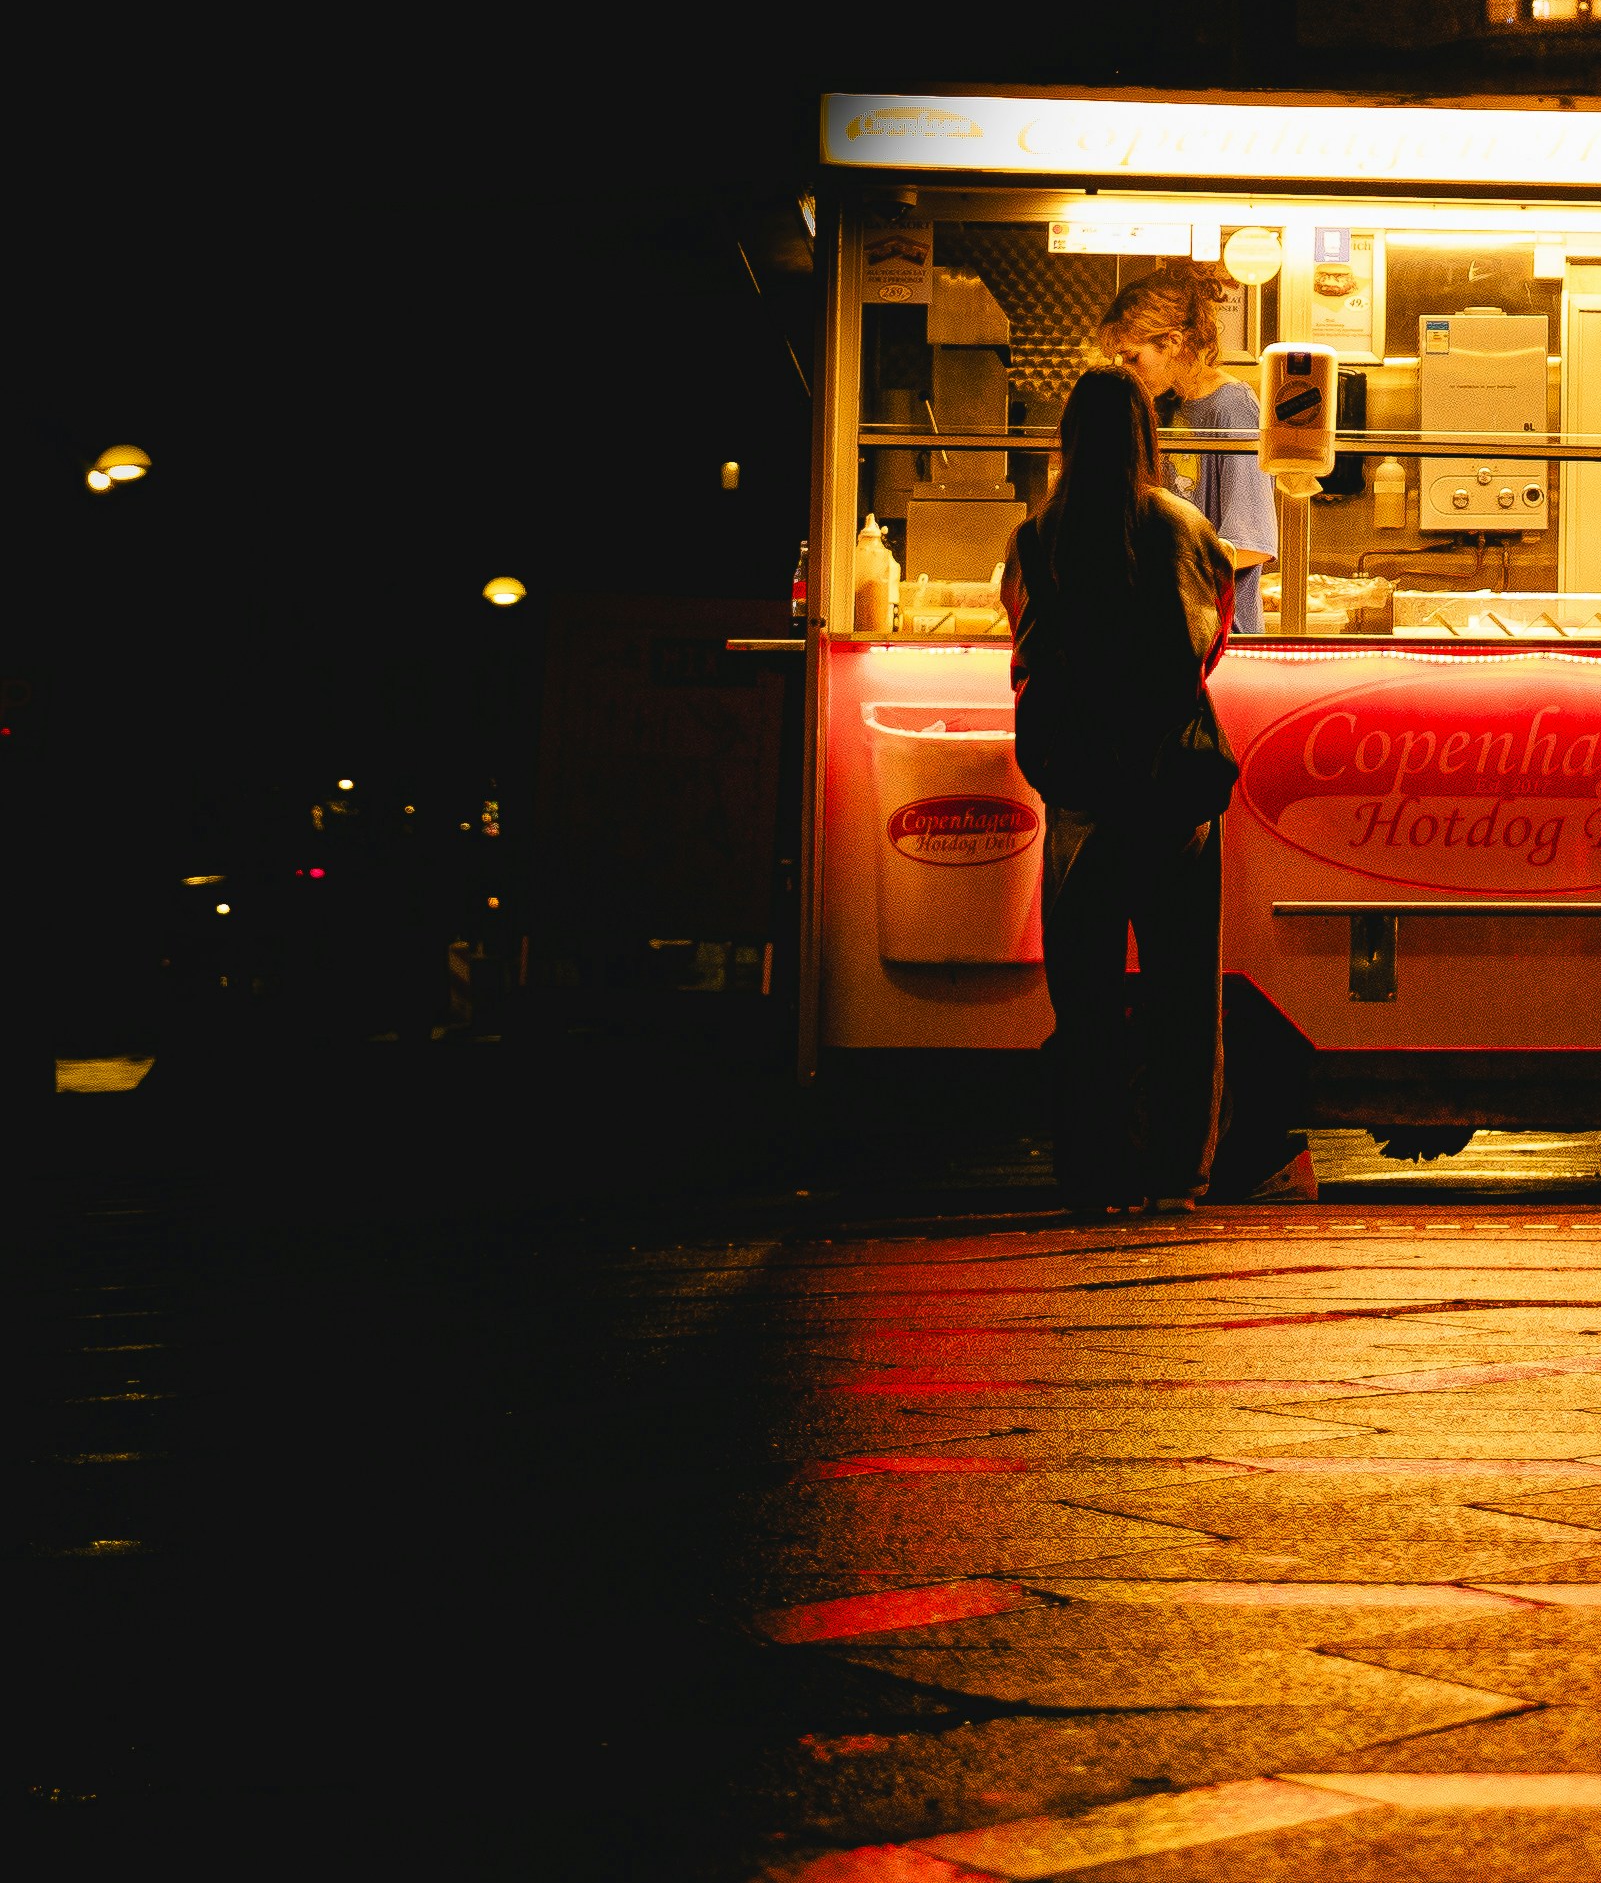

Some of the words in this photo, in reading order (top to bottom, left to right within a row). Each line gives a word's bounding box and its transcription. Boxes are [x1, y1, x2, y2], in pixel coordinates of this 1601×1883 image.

[1016, 113, 1501, 171] Copenhagen
[902, 807, 1022, 843] Copenhagen
[915, 835, 978, 855] Hotdog
[983, 835, 1016, 851] Deli
[1349, 800, 1566, 867] Hotdog
